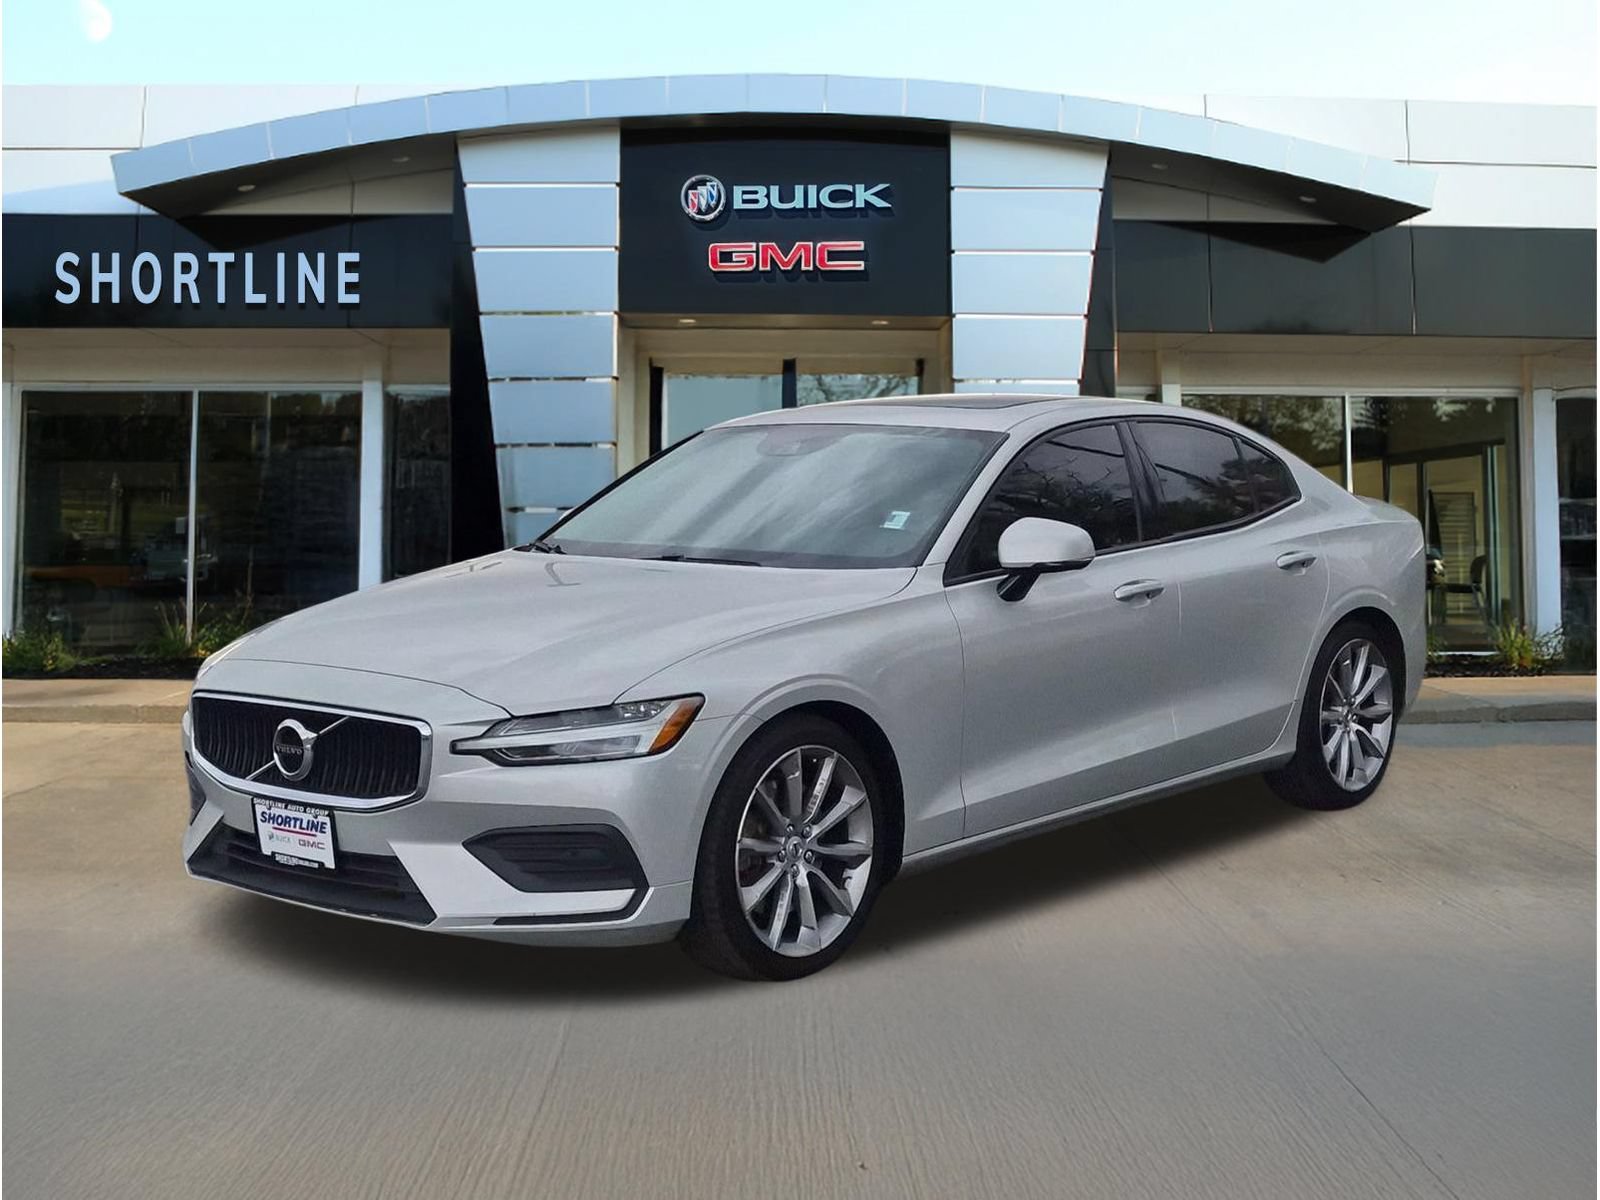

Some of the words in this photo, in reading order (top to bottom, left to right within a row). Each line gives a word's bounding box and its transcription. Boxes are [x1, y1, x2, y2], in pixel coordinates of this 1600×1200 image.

[733, 183, 892, 210] BUICK
[708, 241, 865, 272] GMC
[54, 251, 361, 304] SHORTLINE
[276, 745, 303, 755] VOLVO
[253, 798, 286, 809] SHORTLINE
[287, 804, 304, 812] AUTO
[306, 807, 329, 816] GROUP
[260, 811, 328, 834] SHORTLINE
[298, 839, 326, 850] GMC
